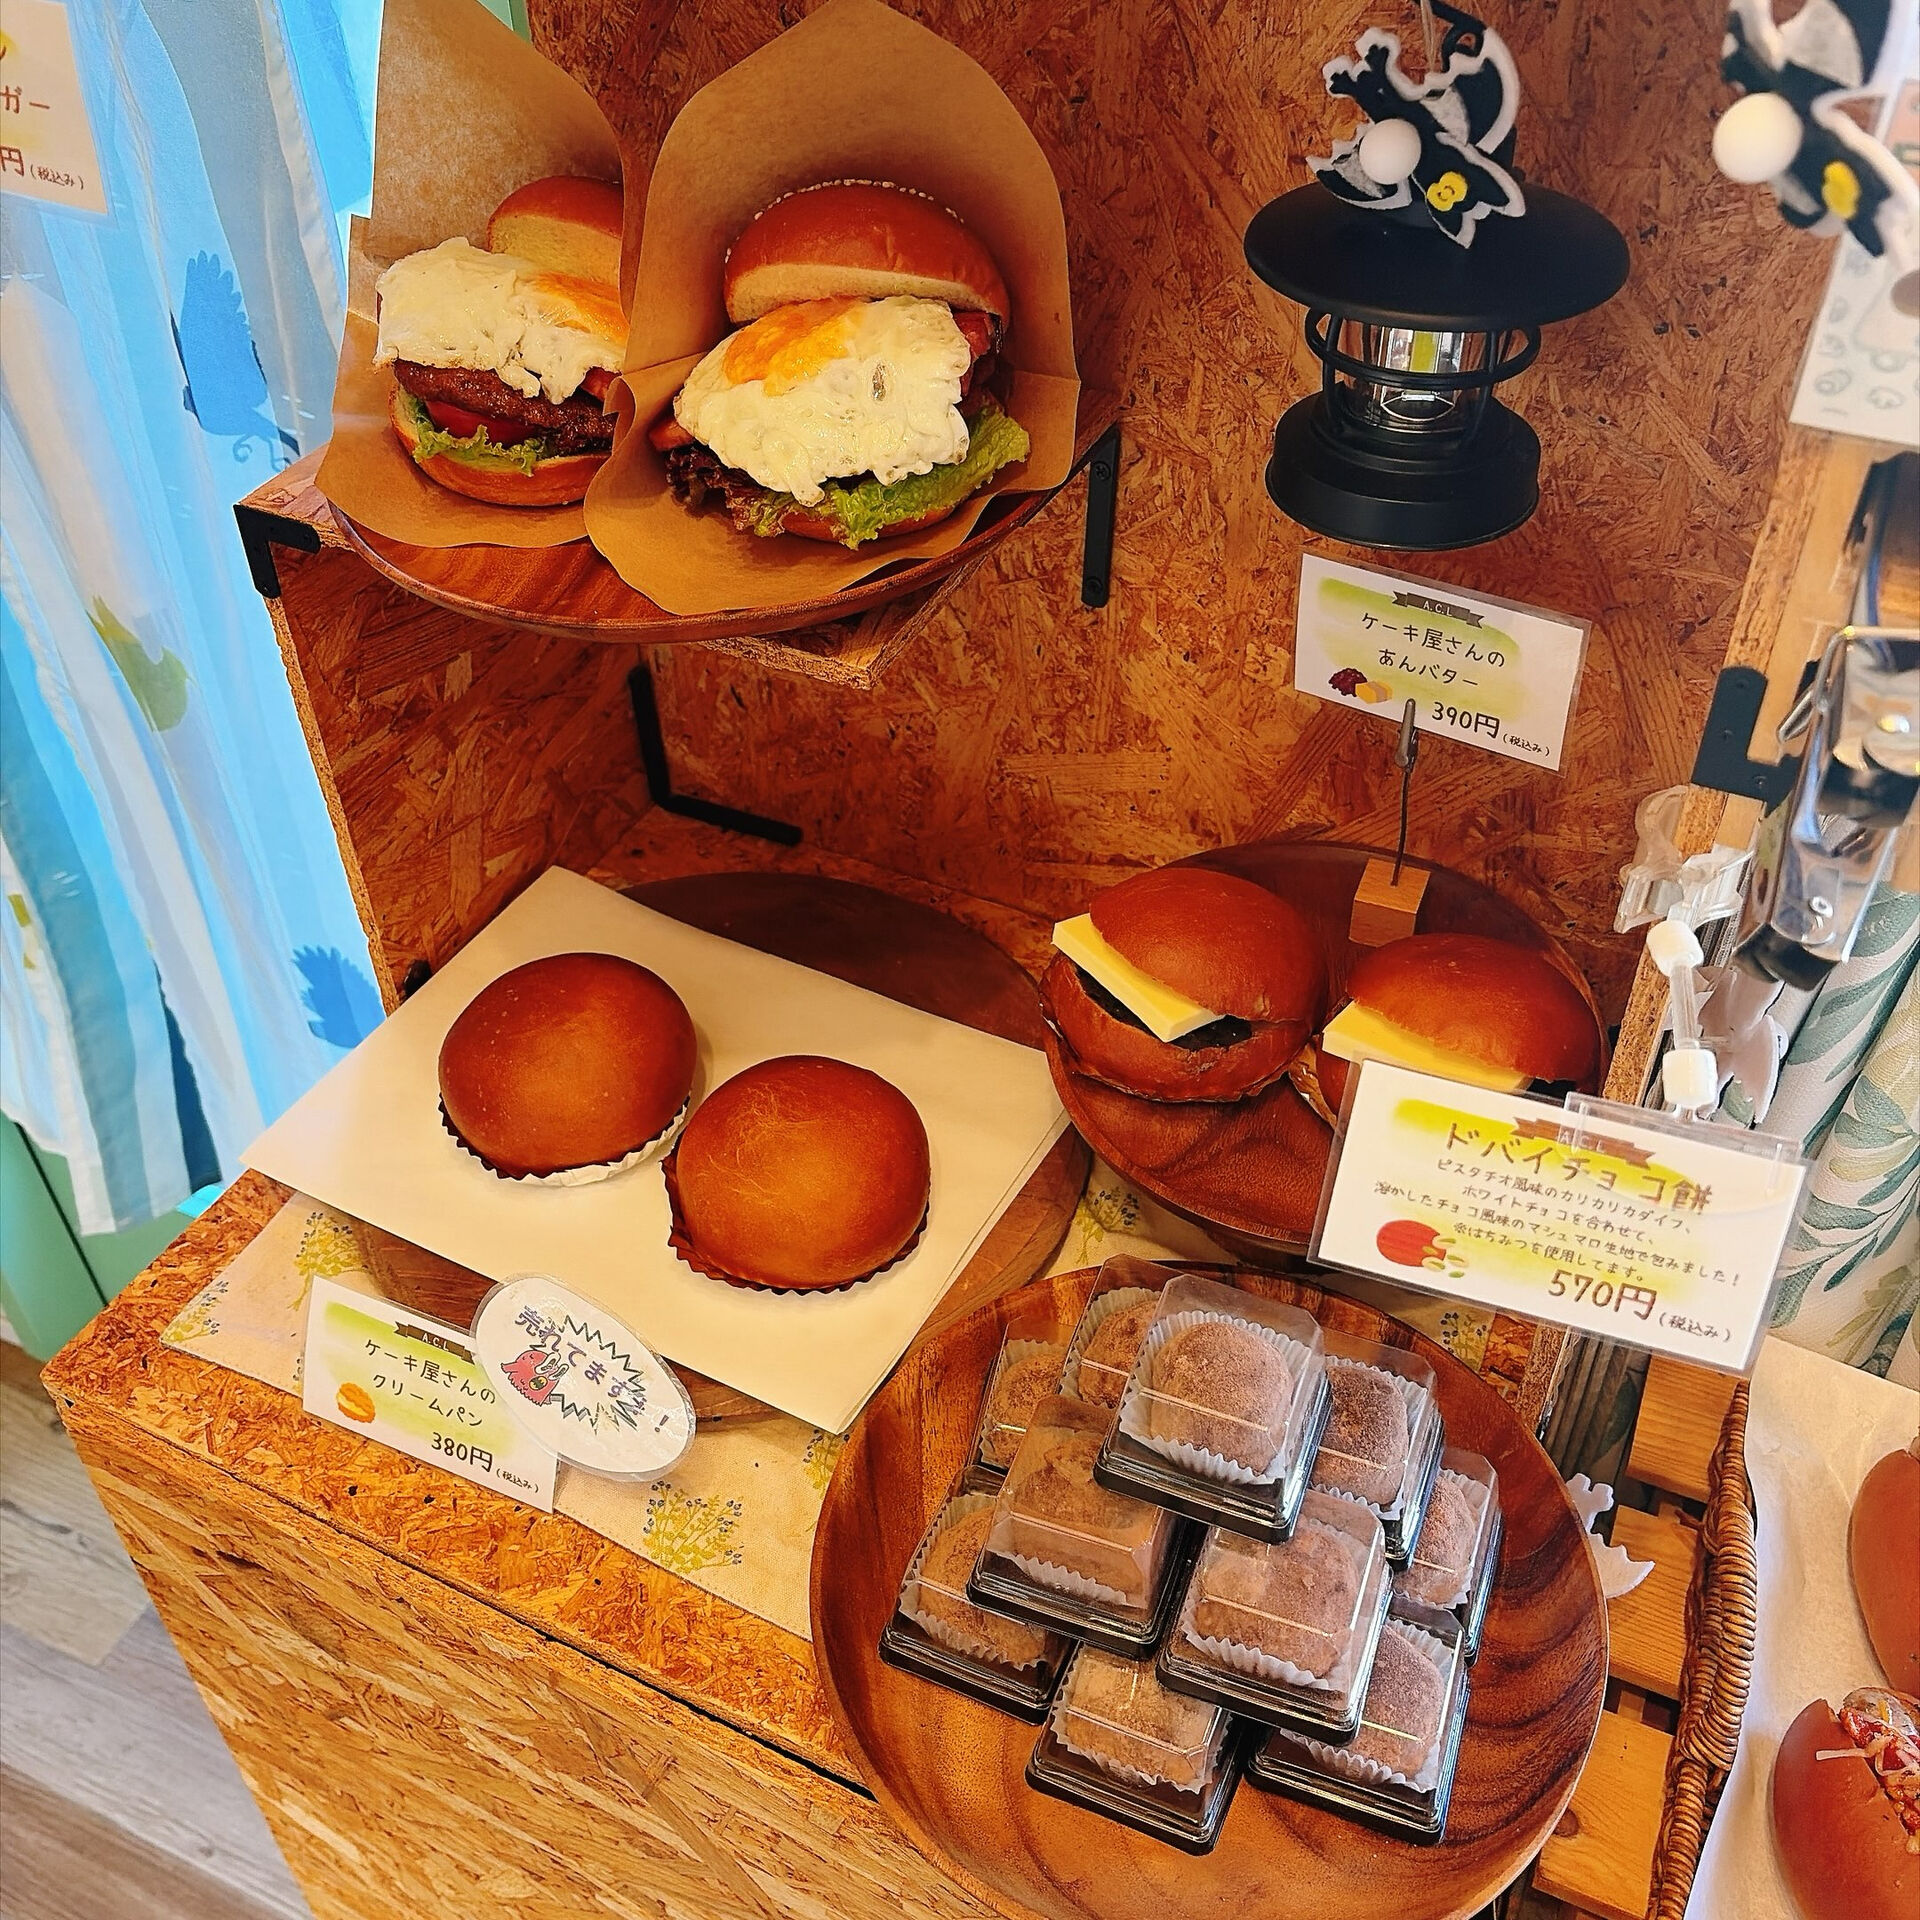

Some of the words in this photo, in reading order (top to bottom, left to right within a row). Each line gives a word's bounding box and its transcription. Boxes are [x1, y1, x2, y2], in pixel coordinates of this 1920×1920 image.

[1362, 612, 1505, 668] ケーキ屋さんの
[1378, 648, 1478, 686] あんバター
[1438, 1160, 1692, 1235] ピスタチオ風味のカリカリカダイフ、
[1445, 1122, 1712, 1216] ドバイチョコ餅
[1461, 1185, 1653, 1245] ホワイトチョコを合わせて、
[365, 1339, 496, 1405] ケーキ屋さんの
[372, 1374, 483, 1427] クリームパン
